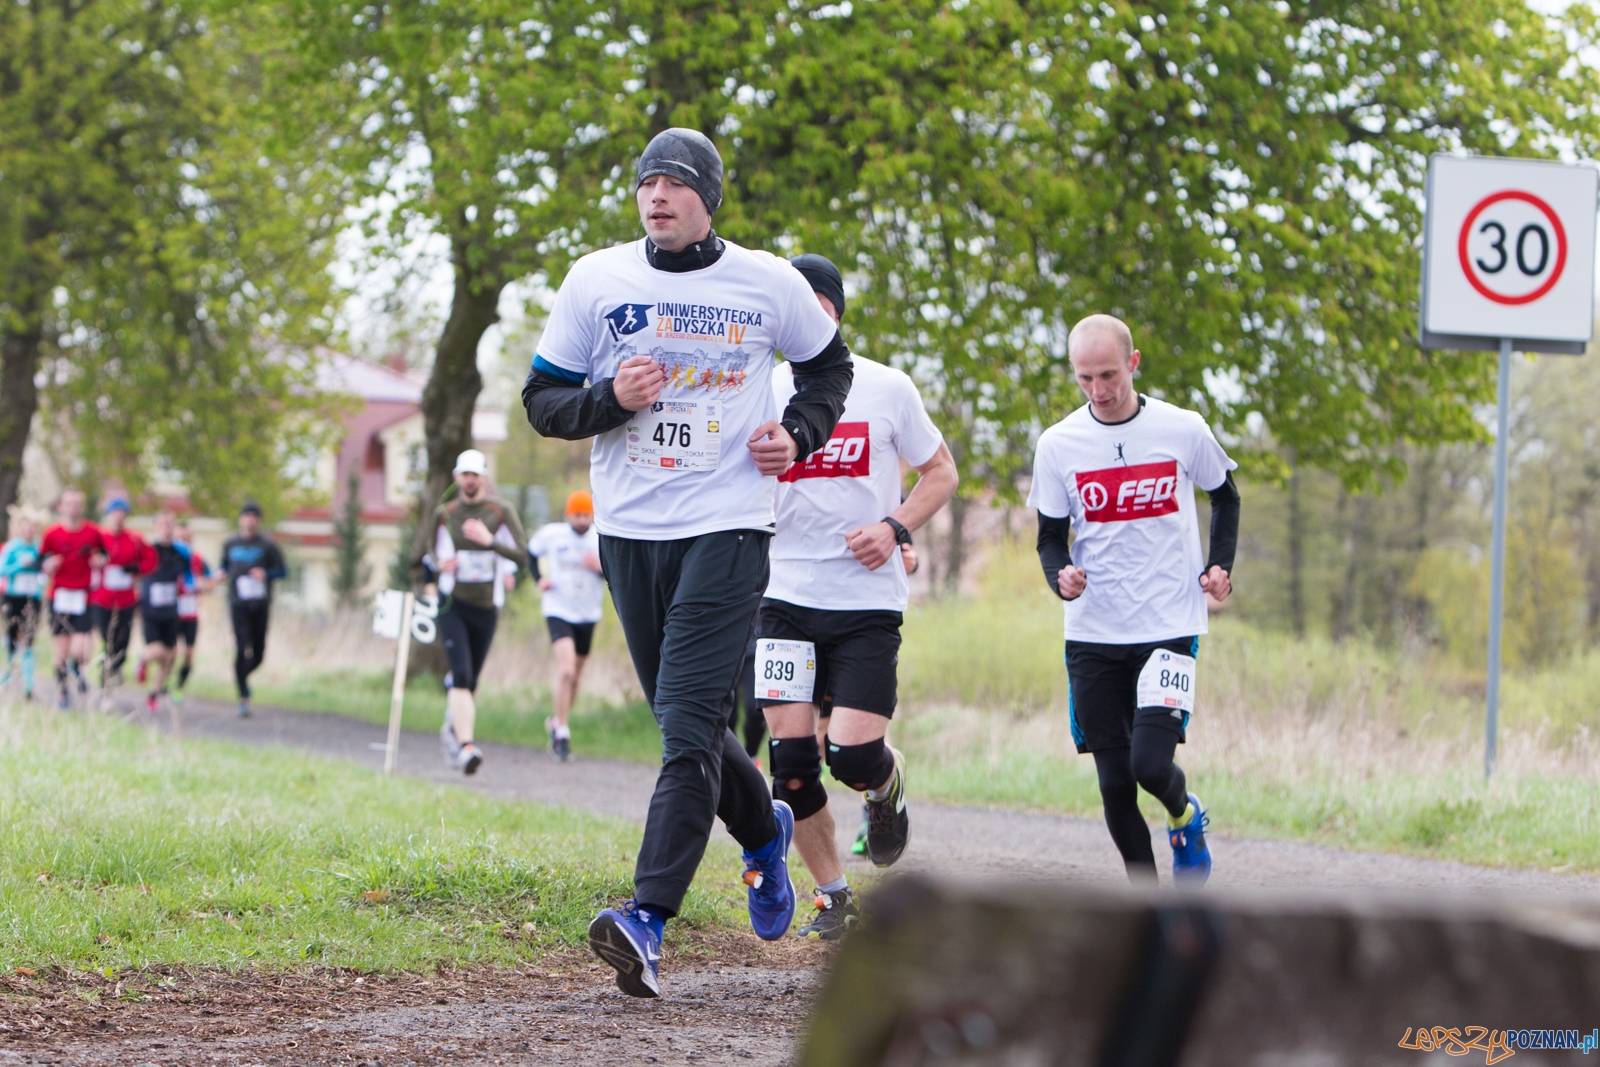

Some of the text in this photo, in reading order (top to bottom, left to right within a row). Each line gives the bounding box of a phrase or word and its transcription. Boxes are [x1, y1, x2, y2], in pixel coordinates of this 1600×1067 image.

[1476, 220, 1549, 276] 30
[657, 302, 762, 327] UNIWERSYTECKA
[656, 317, 747, 345] ZADYSZKA IV
[652, 422, 691, 448] 476
[1116, 476, 1175, 506] FSO
[764, 660, 794, 681] 839
[1160, 669, 1189, 692] 840
